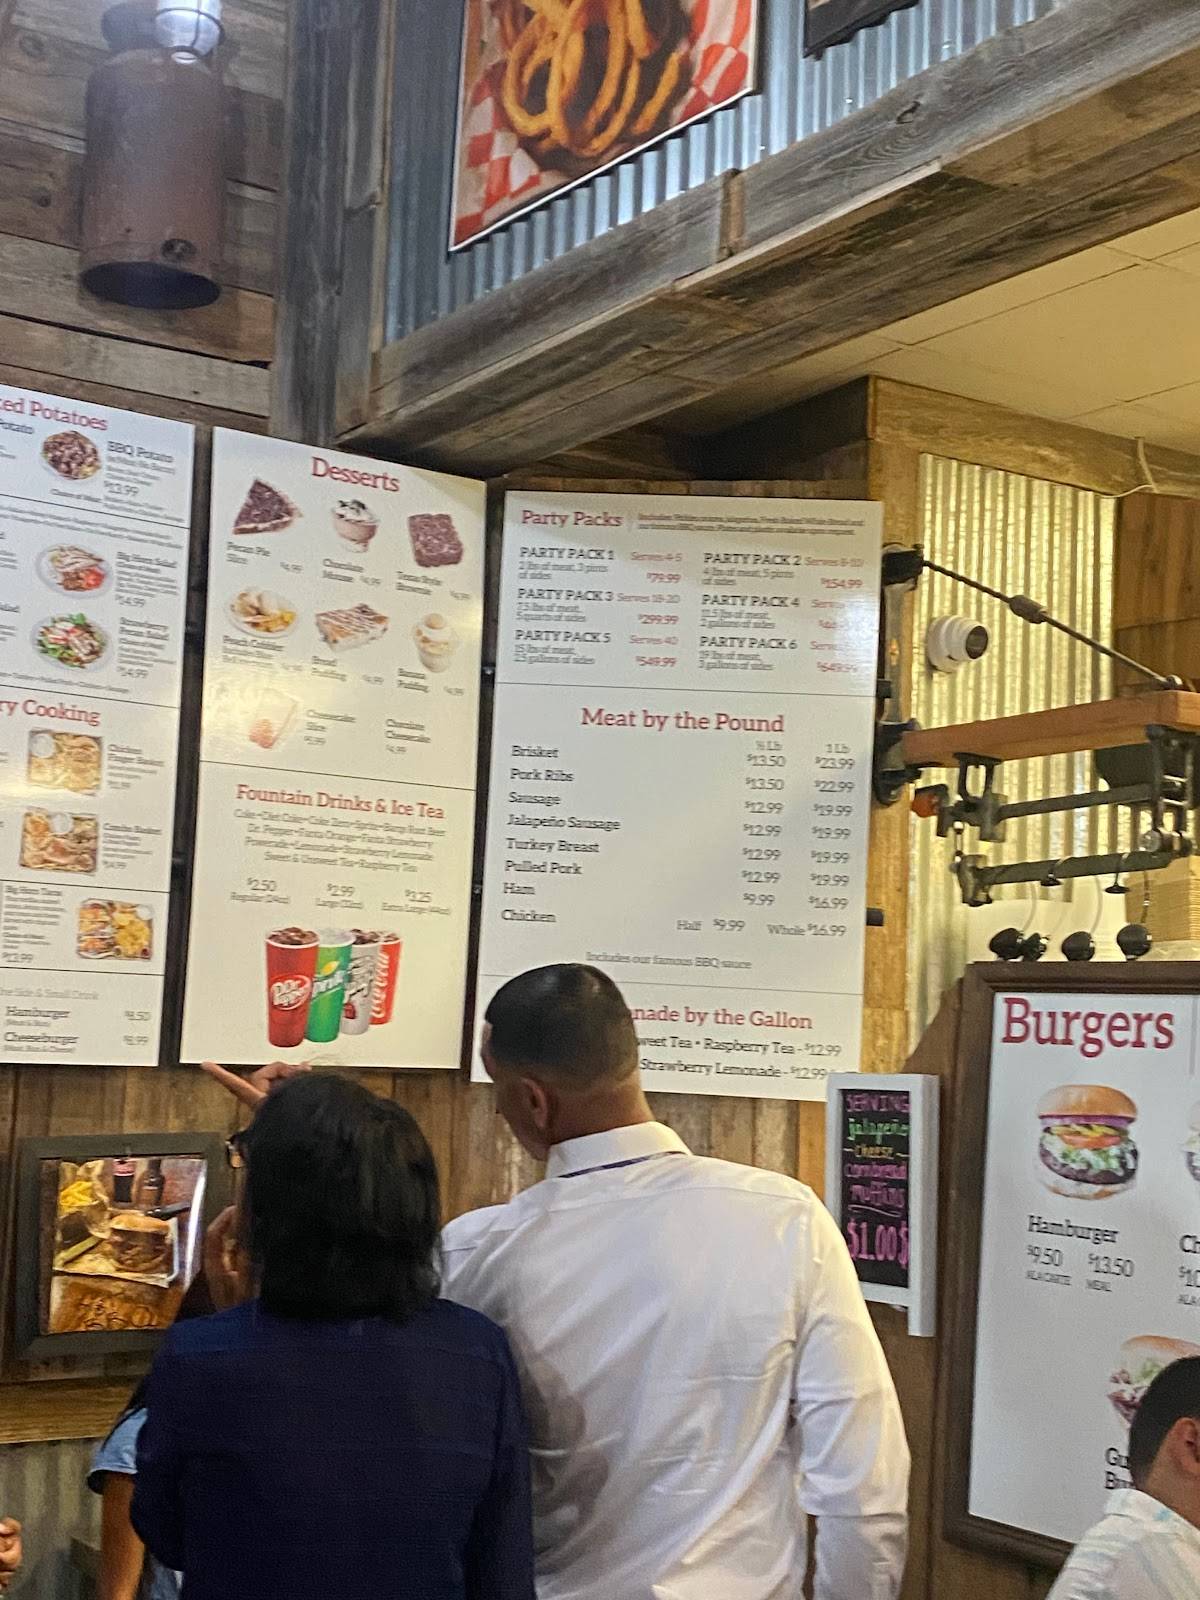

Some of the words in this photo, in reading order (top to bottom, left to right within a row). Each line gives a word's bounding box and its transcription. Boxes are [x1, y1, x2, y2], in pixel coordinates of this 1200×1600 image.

[0, 398, 25, 414] ed
[29, 401, 108, 431] Potatoes
[0, 418, 35, 434] otato
[107, 440, 137, 457] BBQ
[136, 446, 174, 463] Potato
[311, 456, 400, 492] Desserts
[521, 510, 569, 528] Party
[573, 511, 624, 527] Packs
[519, 547, 565, 559] PARTY
[567, 548, 606, 560] PACK
[608, 550, 615, 560] 1
[703, 552, 750, 564] PARTY
[752, 554, 790, 565] PACK
[793, 555, 801, 566] 2
[517, 588, 564, 600] PARTY
[566, 590, 603, 601] PACK
[605, 591, 613, 602] 3
[702, 594, 749, 606] PARTY
[751, 596, 789, 607] PACK
[790, 597, 799, 607] 4
[515, 629, 561, 641] PARTY
[563, 631, 601, 642] PACK
[603, 632, 612, 643] 5
[700, 636, 747, 648] PARTY
[749, 637, 787, 649] PACK
[789, 639, 798, 649] 6
[22, 699, 101, 727] Cooking
[581, 707, 637, 727] Meat
[642, 709, 669, 731] by
[674, 711, 711, 730] the
[714, 712, 785, 733] Pound
[512, 745, 559, 758] Brisket
[746, 753, 786, 767] $13.50
[815, 756, 855, 769] $23.99
[510, 767, 541, 780] Pork
[545, 769, 575, 781] Ribs
[745, 777, 785, 790] $13.50
[814, 780, 855, 793] $22.99
[237, 784, 312, 807] Fountain
[316, 791, 373, 813] Drinks
[374, 798, 387, 813] &
[391, 800, 413, 816] Ice
[416, 802, 445, 819] Tea
[508, 791, 561, 806] Sausage
[744, 800, 783, 814] $12.99
[813, 803, 853, 817] $19.99
[507, 814, 566, 829] Jalapeño
[567, 816, 621, 832] Sausage
[743, 823, 782, 837] $12.99
[812, 826, 851, 840] $19.99
[505, 837, 556, 853] Turkey
[558, 840, 600, 853] Breast
[742, 848, 781, 861] $12.99
[811, 850, 850, 863] $19.99
[505, 860, 547, 873] Pulled
[550, 862, 583, 874] Pork
[742, 870, 781, 883] $12.99
[810, 873, 849, 886] $19.99
[247, 877, 277, 891] $2.50
[503, 882, 535, 895] Ham
[743, 893, 775, 906] $9.99
[808, 896, 849, 910] $16.99
[502, 909, 557, 923] Chicken
[713, 918, 745, 931] $9.99
[807, 923, 847, 936] $16.99
[6, 1006, 71, 1020] Hamburger
[630, 1005, 680, 1023] nade
[684, 1006, 708, 1026] by
[713, 1008, 745, 1025] the
[750, 1010, 813, 1029] Gallon
[1002, 996, 1175, 1058] Burgers
[4, 1032, 80, 1046] Cheeseburger
[637, 1036, 667, 1048] weet
[669, 1036, 693, 1048] Tea
[703, 1037, 770, 1054] Raspberry
[771, 1041, 795, 1054] Tea
[640, 1058, 713, 1076] Strawberry
[715, 1062, 781, 1077] Lemonade
[1028, 1214, 1120, 1244] Hamburger
[1027, 1244, 1064, 1267] $9.50
[1088, 1252, 1136, 1278] $13.50
